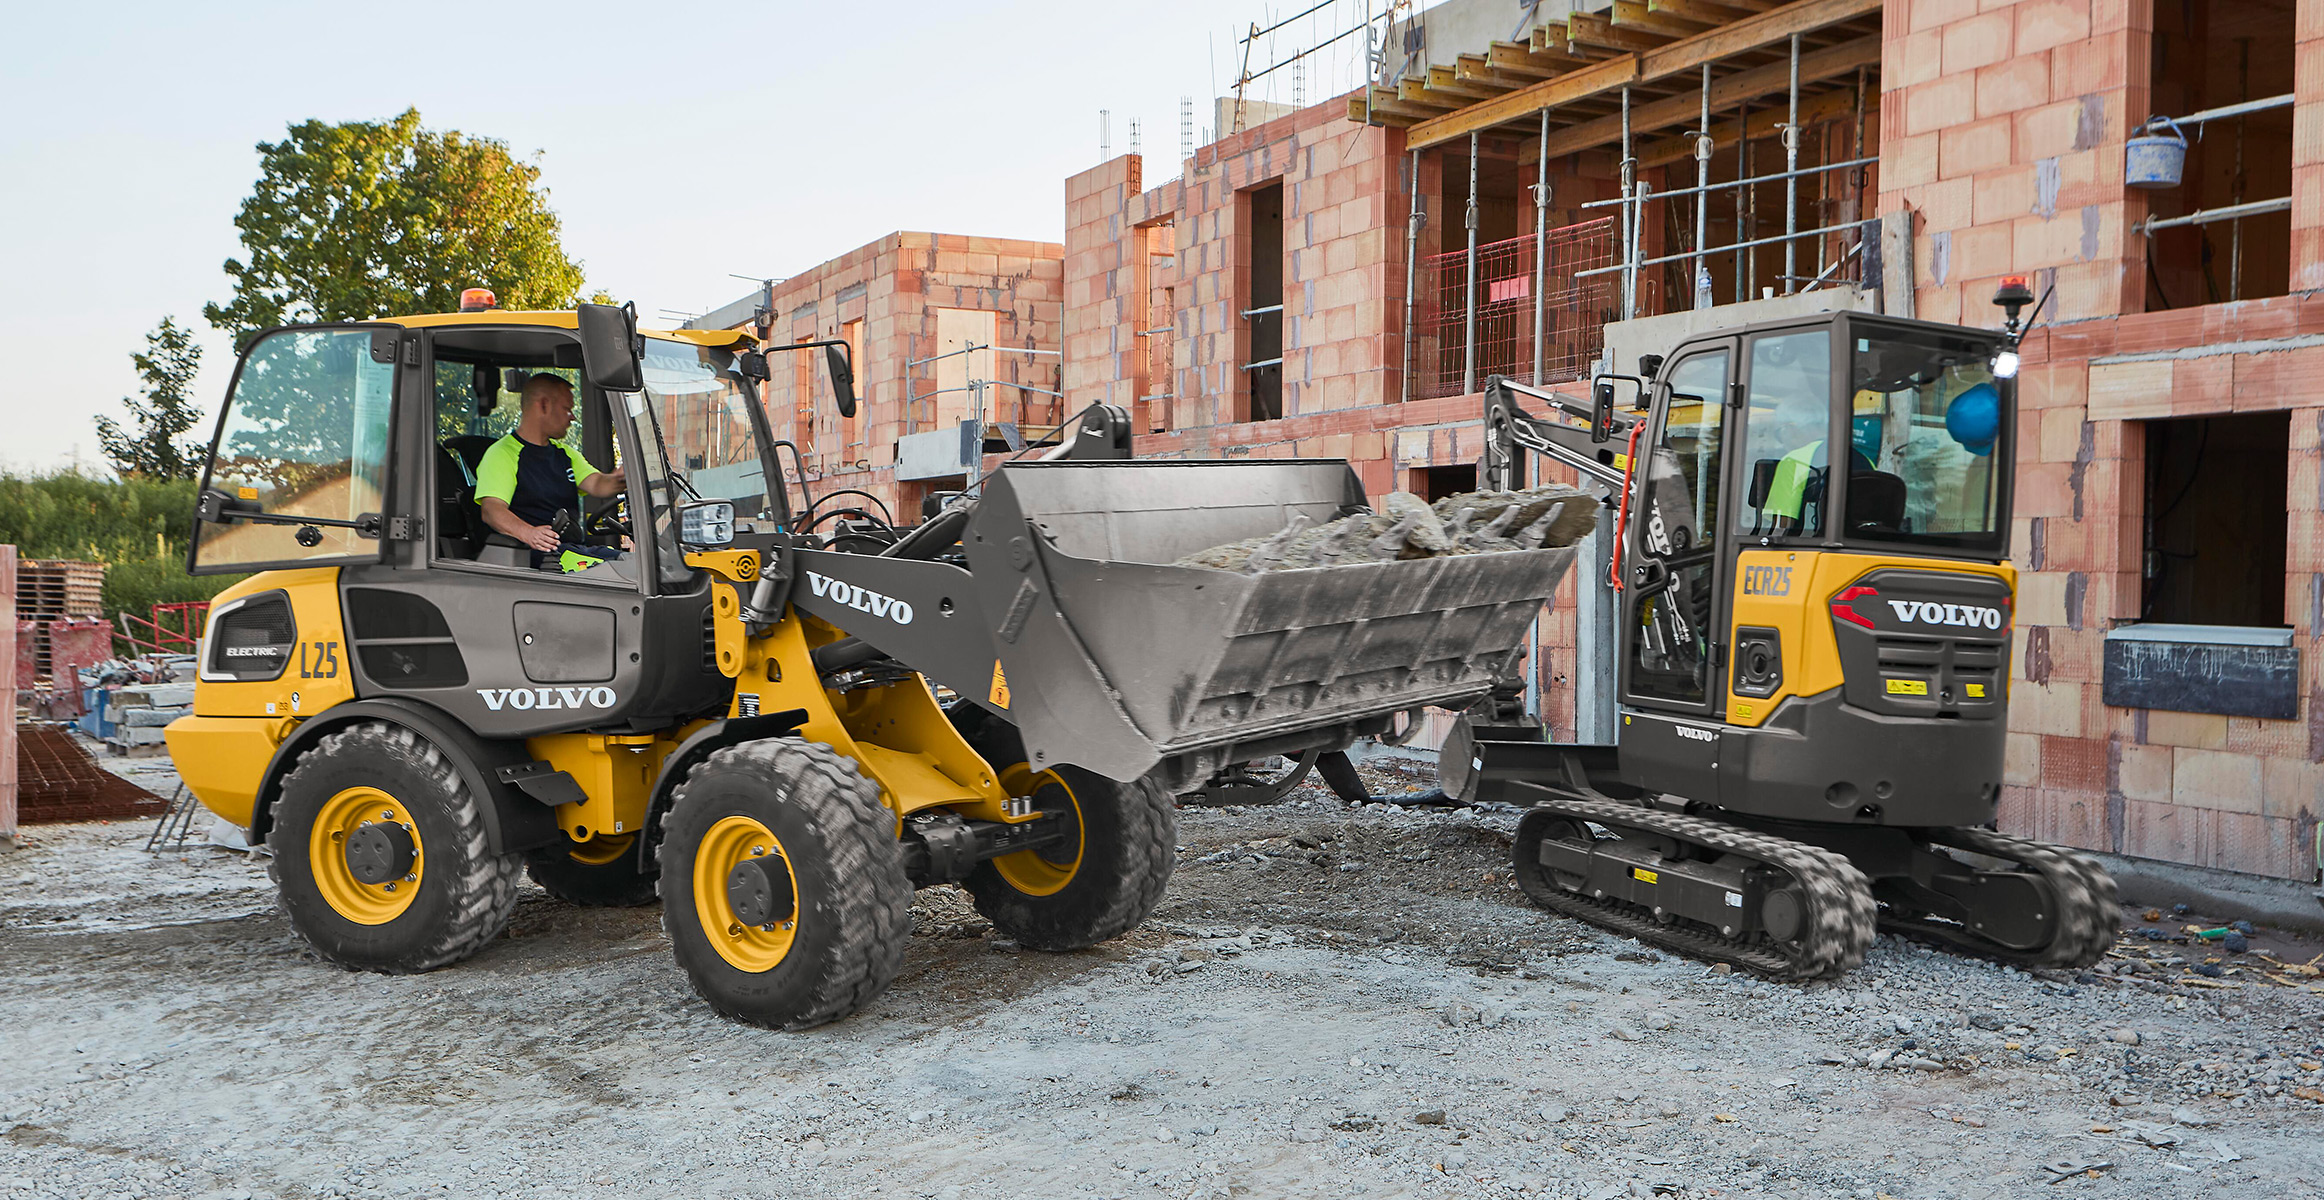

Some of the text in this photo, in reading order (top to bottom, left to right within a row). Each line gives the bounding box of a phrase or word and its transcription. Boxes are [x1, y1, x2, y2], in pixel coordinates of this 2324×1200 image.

[1743, 565, 1793, 597] ECR25
[805, 570, 914, 625] VOLVO
[1887, 600, 2002, 630] VOLVO
[226, 647, 279, 656] ELECTRIC
[301, 642, 338, 678] L25
[476, 686, 617, 711] VOLVO
[1675, 725, 1713, 742] VOLVO
